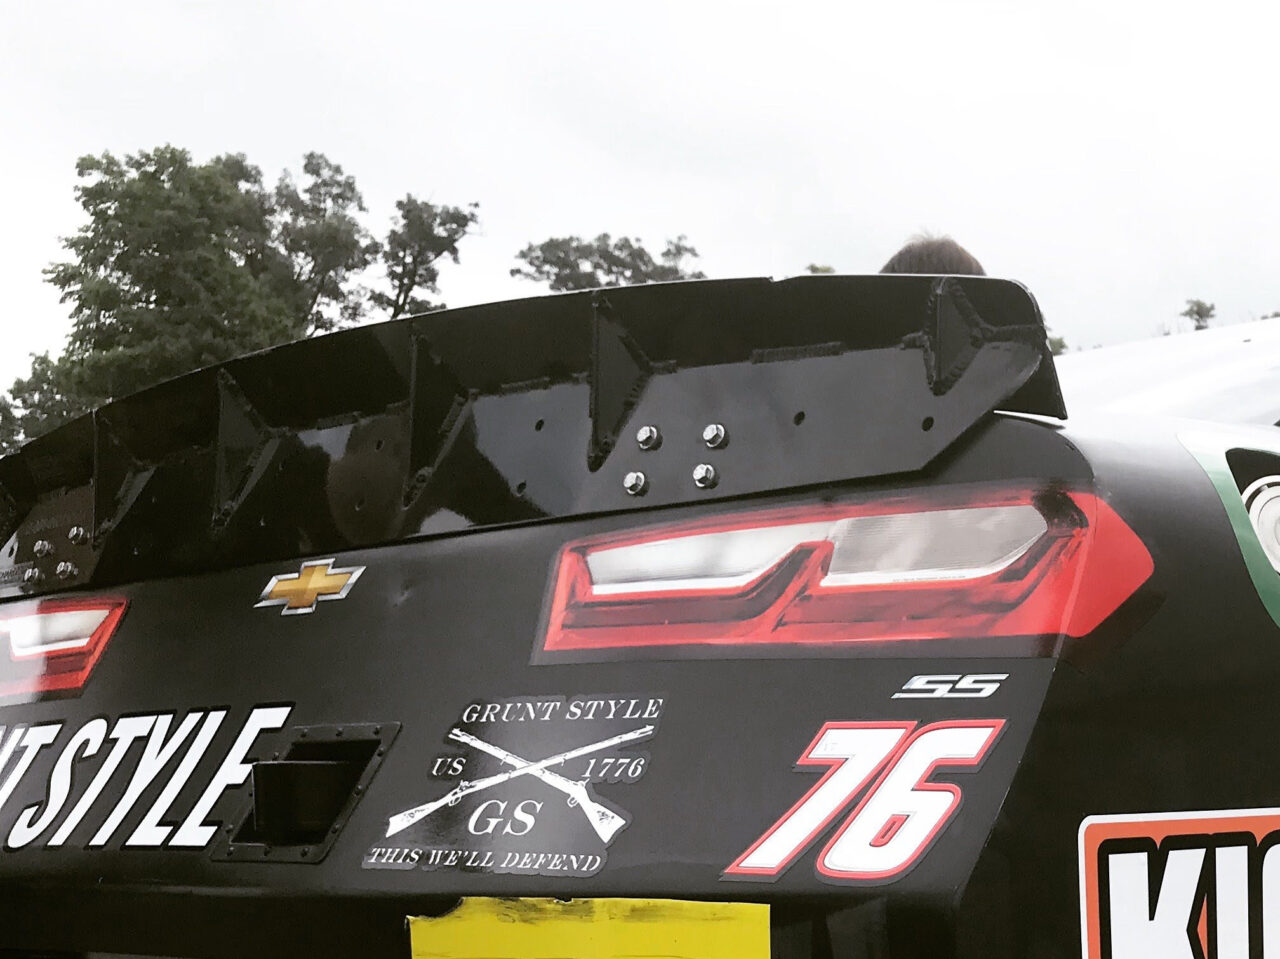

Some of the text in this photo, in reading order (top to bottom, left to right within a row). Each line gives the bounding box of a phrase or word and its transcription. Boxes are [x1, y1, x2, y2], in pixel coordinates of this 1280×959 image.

[890, 673, 1010, 699] SS
[462, 698, 664, 723] GRUNT STYLE
[7, 706, 292, 849] STYLE
[431, 757, 645, 778] US 1776
[724, 718, 1007, 880] 76
[467, 800, 543, 836] GS
[367, 847, 601, 873] THIS WE'LL DEFEND
